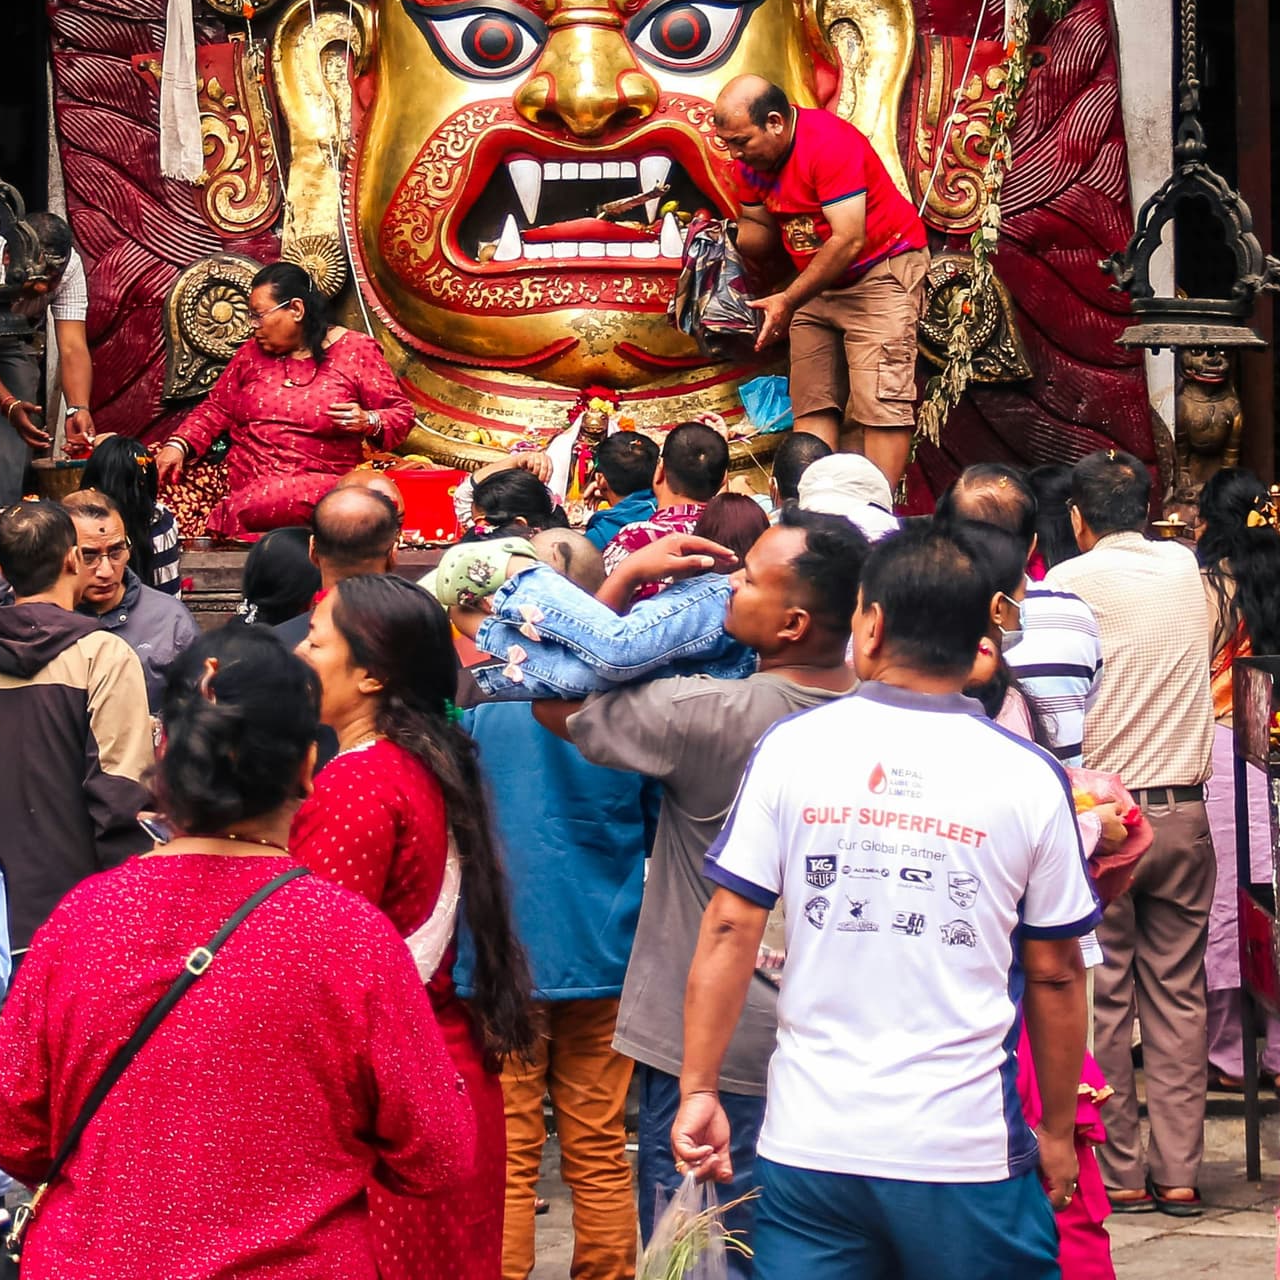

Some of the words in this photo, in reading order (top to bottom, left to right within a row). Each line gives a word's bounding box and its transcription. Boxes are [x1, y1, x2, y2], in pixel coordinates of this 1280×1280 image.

[803, 807, 851, 825] GULF
[858, 807, 987, 849] SUPERFLEET
[861, 839, 898, 856] Global
[901, 845, 947, 862] Partner
[809, 858, 833, 872] TAG
[807, 873, 836, 887] HEUER
